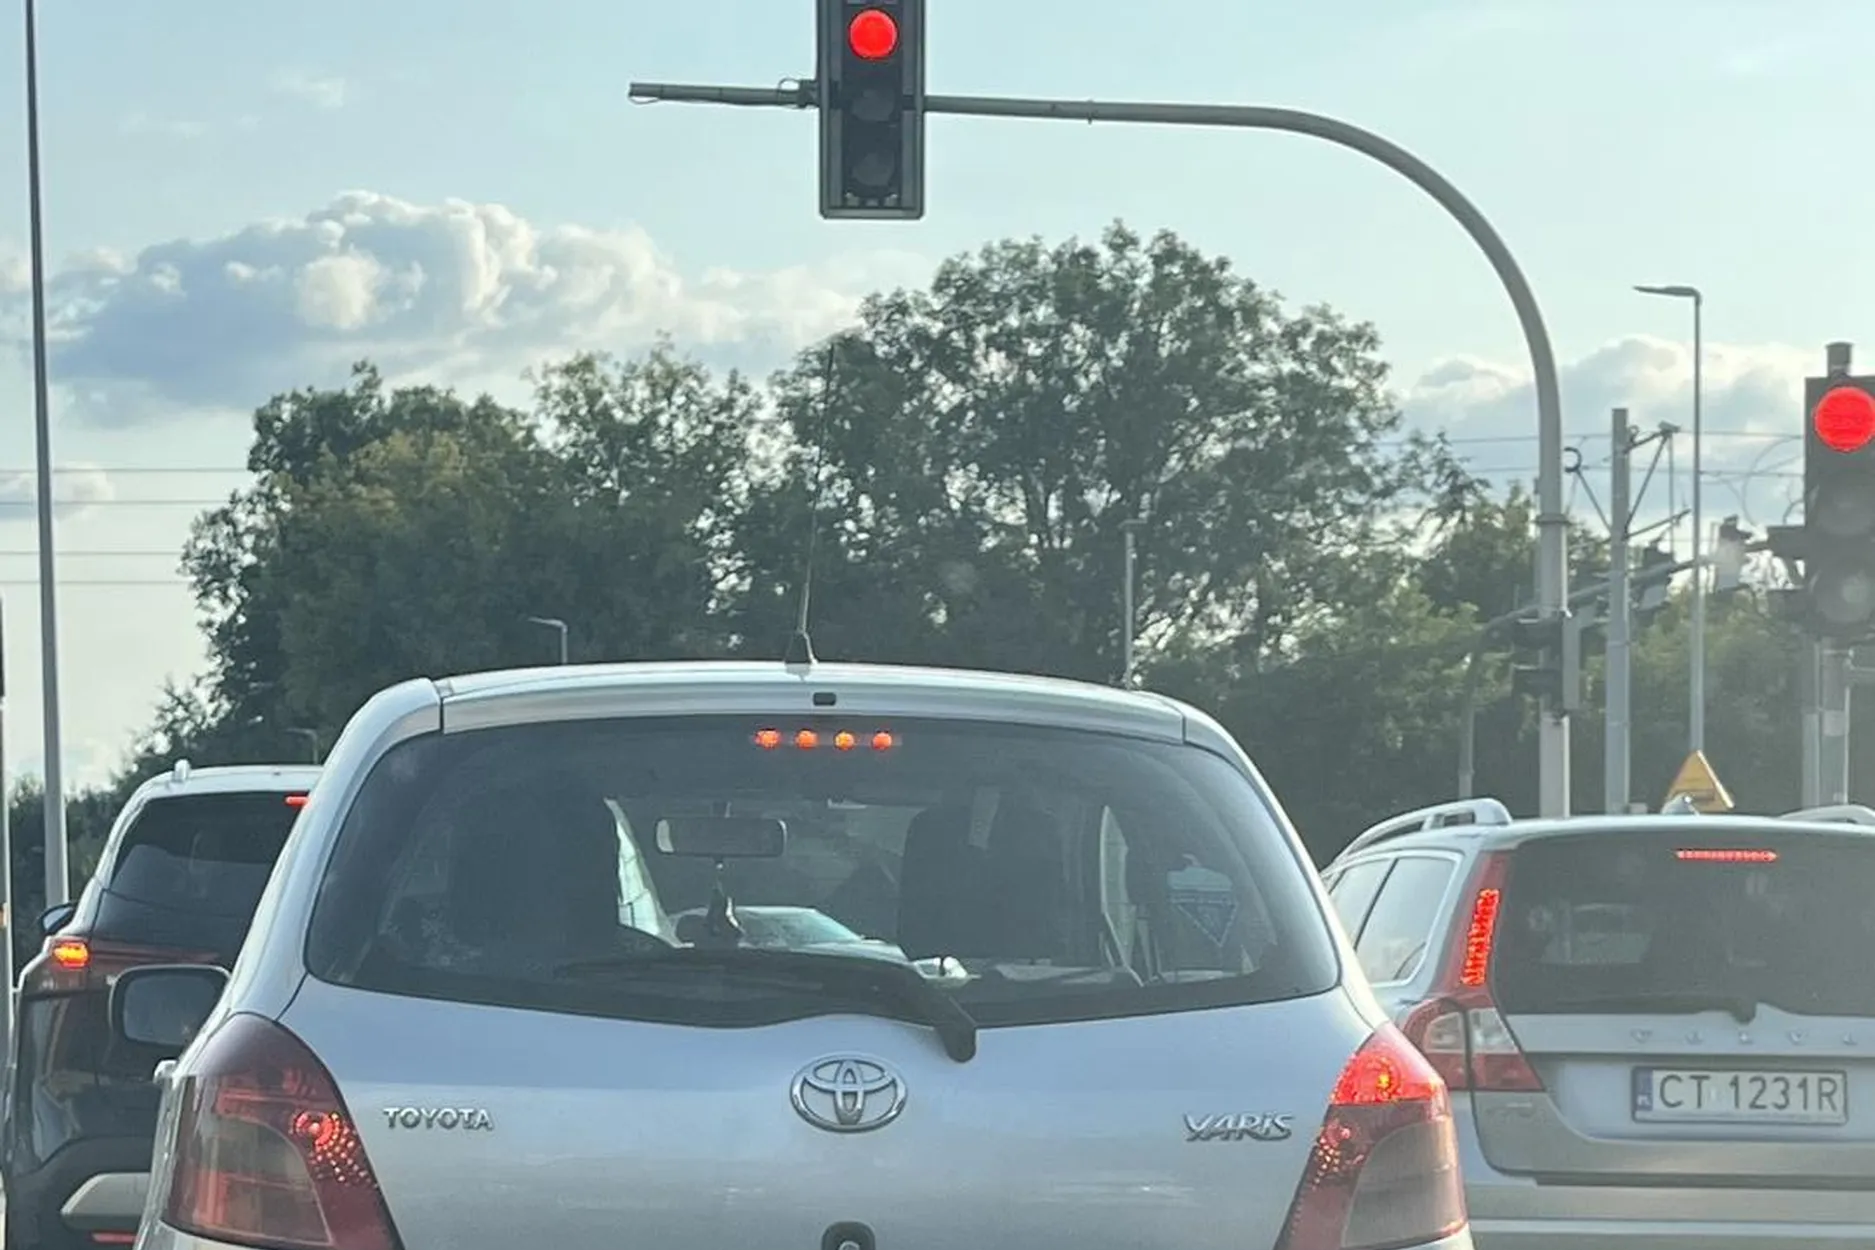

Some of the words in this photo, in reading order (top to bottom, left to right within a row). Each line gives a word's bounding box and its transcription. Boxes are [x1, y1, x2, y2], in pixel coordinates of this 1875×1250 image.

[1659, 1074, 1711, 1109] CT
[1728, 1074, 1838, 1112] 1231R
[382, 1106, 495, 1131] TOYOTA
[1182, 1113, 1294, 1142] YARIS
